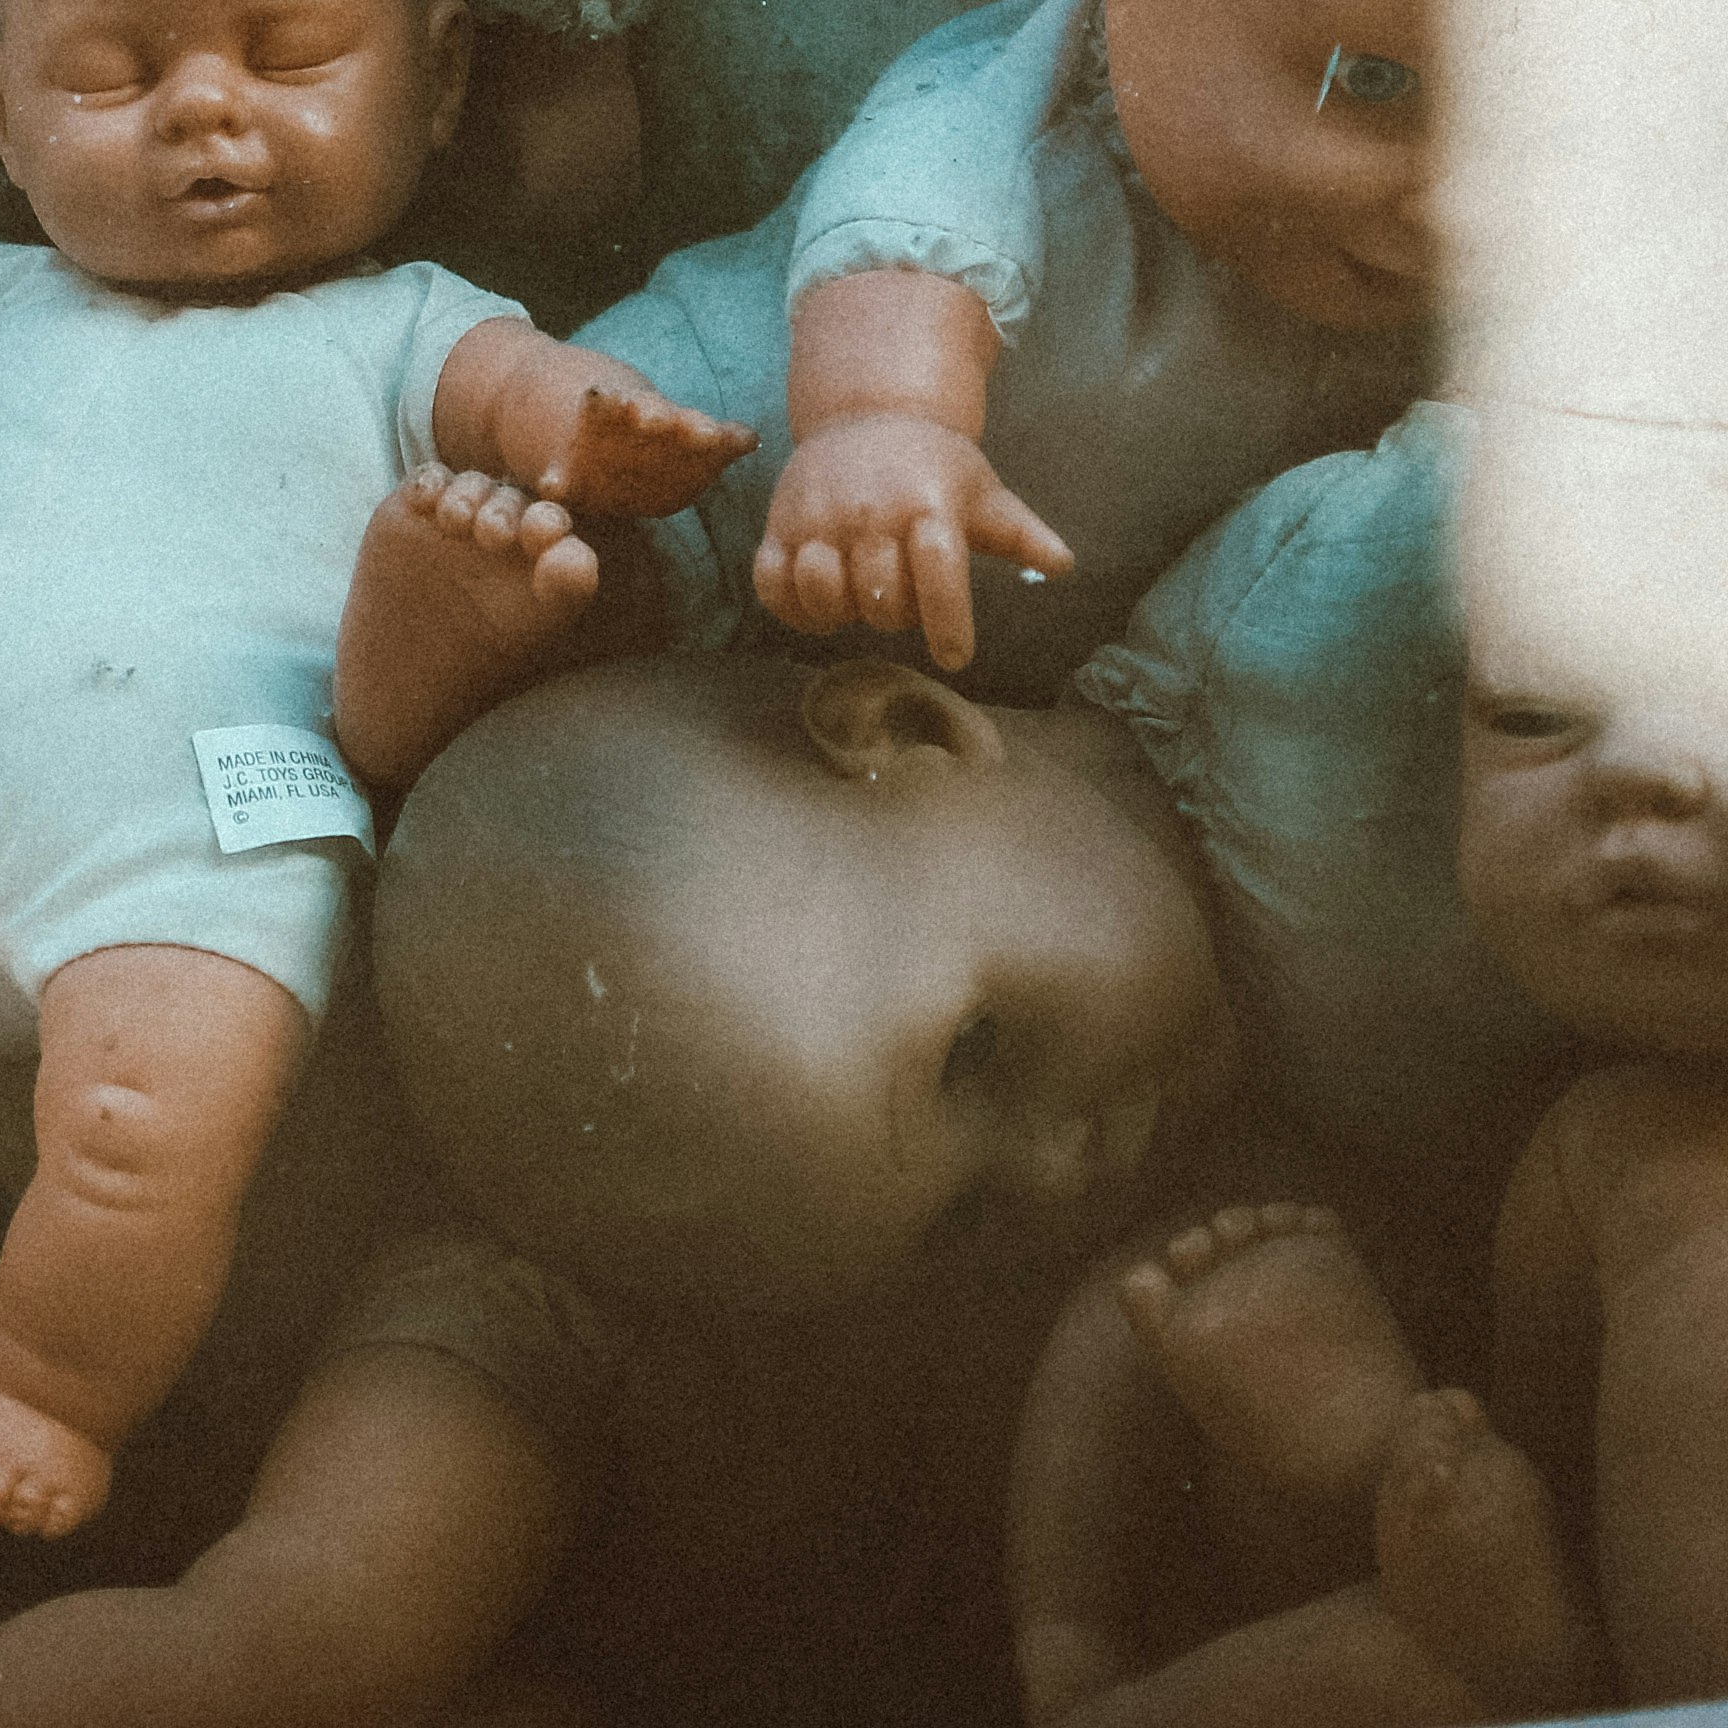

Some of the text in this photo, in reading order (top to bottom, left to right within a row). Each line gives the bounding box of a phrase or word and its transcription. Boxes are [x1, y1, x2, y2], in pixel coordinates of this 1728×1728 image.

[217, 750, 332, 772] MADE IN CHINA
[223, 771, 253, 790] J.C.
[258, 767, 298, 782] TOYS
[227, 784, 340, 808] MIAMI, FL USA
